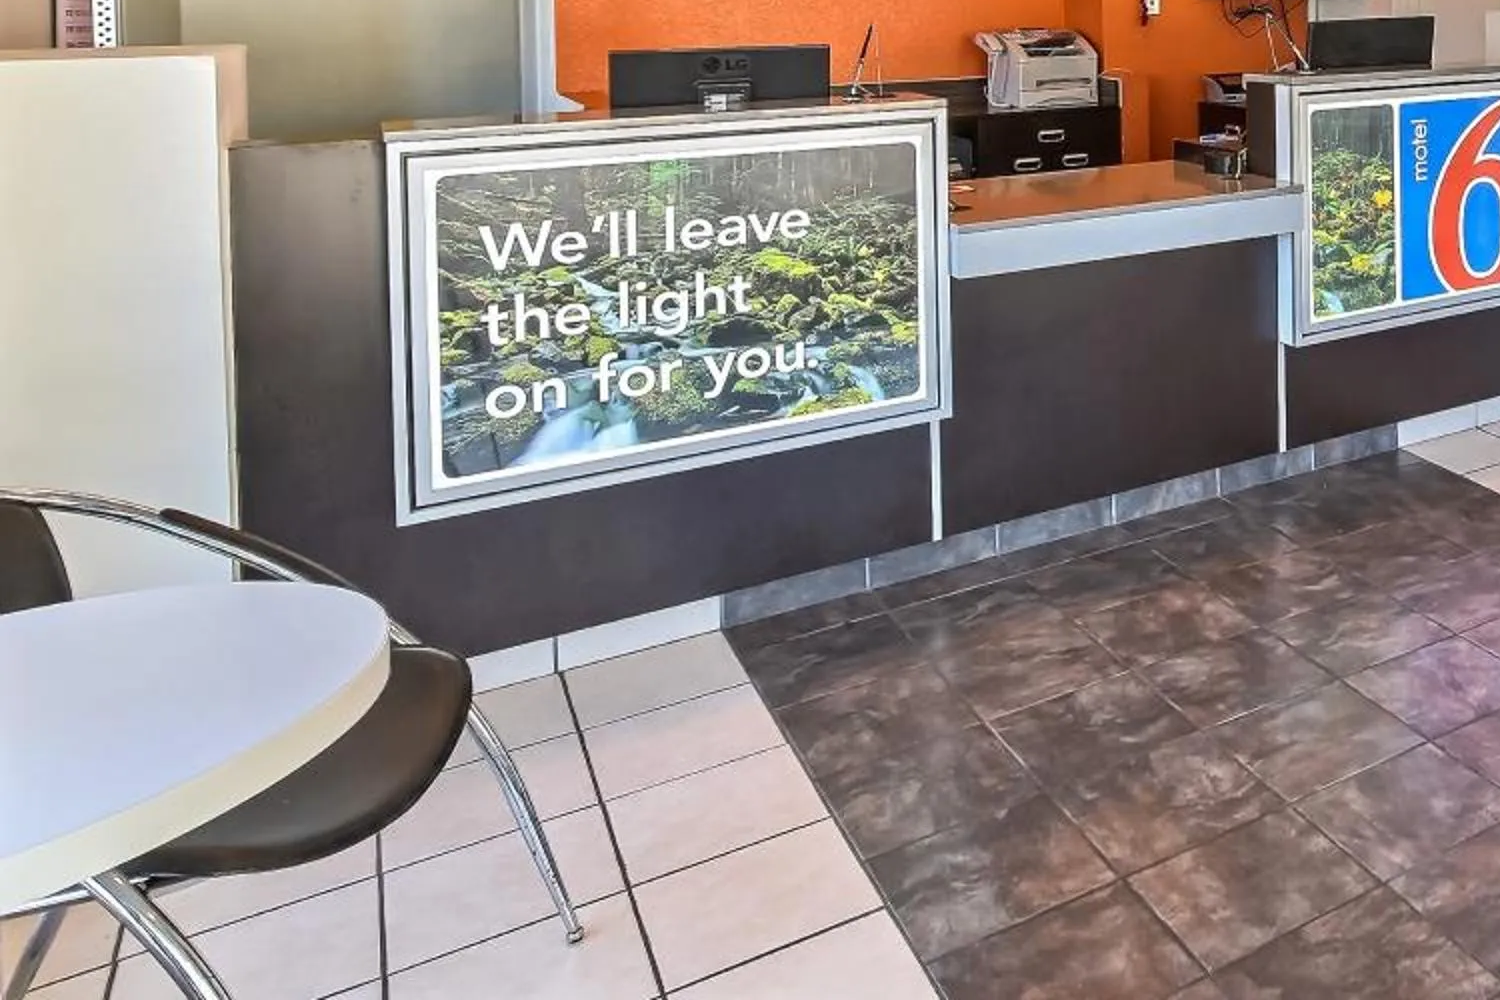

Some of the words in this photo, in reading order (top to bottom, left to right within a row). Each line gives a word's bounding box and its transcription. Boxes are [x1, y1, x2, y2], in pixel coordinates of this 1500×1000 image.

[1410, 119, 1429, 182] motel
[479, 210, 638, 271] We'll
[665, 206, 811, 252] leave
[480, 293, 590, 347] the
[619, 272, 752, 337] light
[484, 374, 567, 420] on
[593, 352, 682, 402] for
[703, 339, 818, 398] you.
